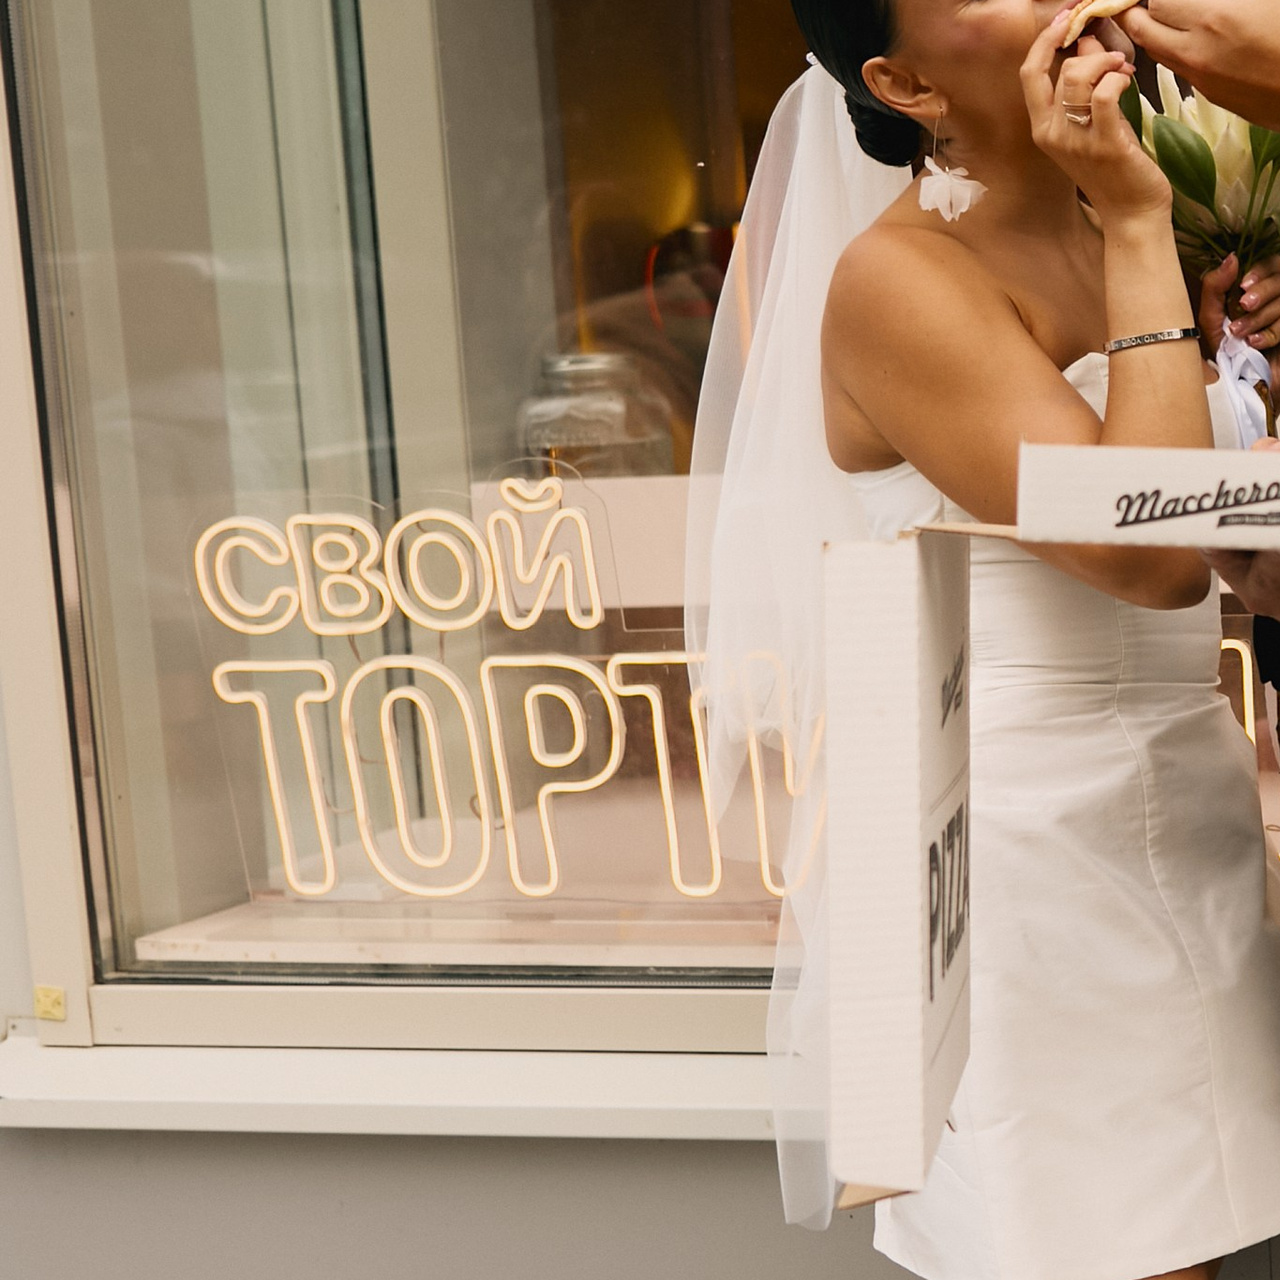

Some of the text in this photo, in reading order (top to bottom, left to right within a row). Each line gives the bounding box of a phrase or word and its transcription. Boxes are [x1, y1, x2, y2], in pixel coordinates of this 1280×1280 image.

[1143, 335, 1156, 343] TO
[195, 477, 605, 634] СВОЙ
[929, 791, 970, 1001] PIZZA
